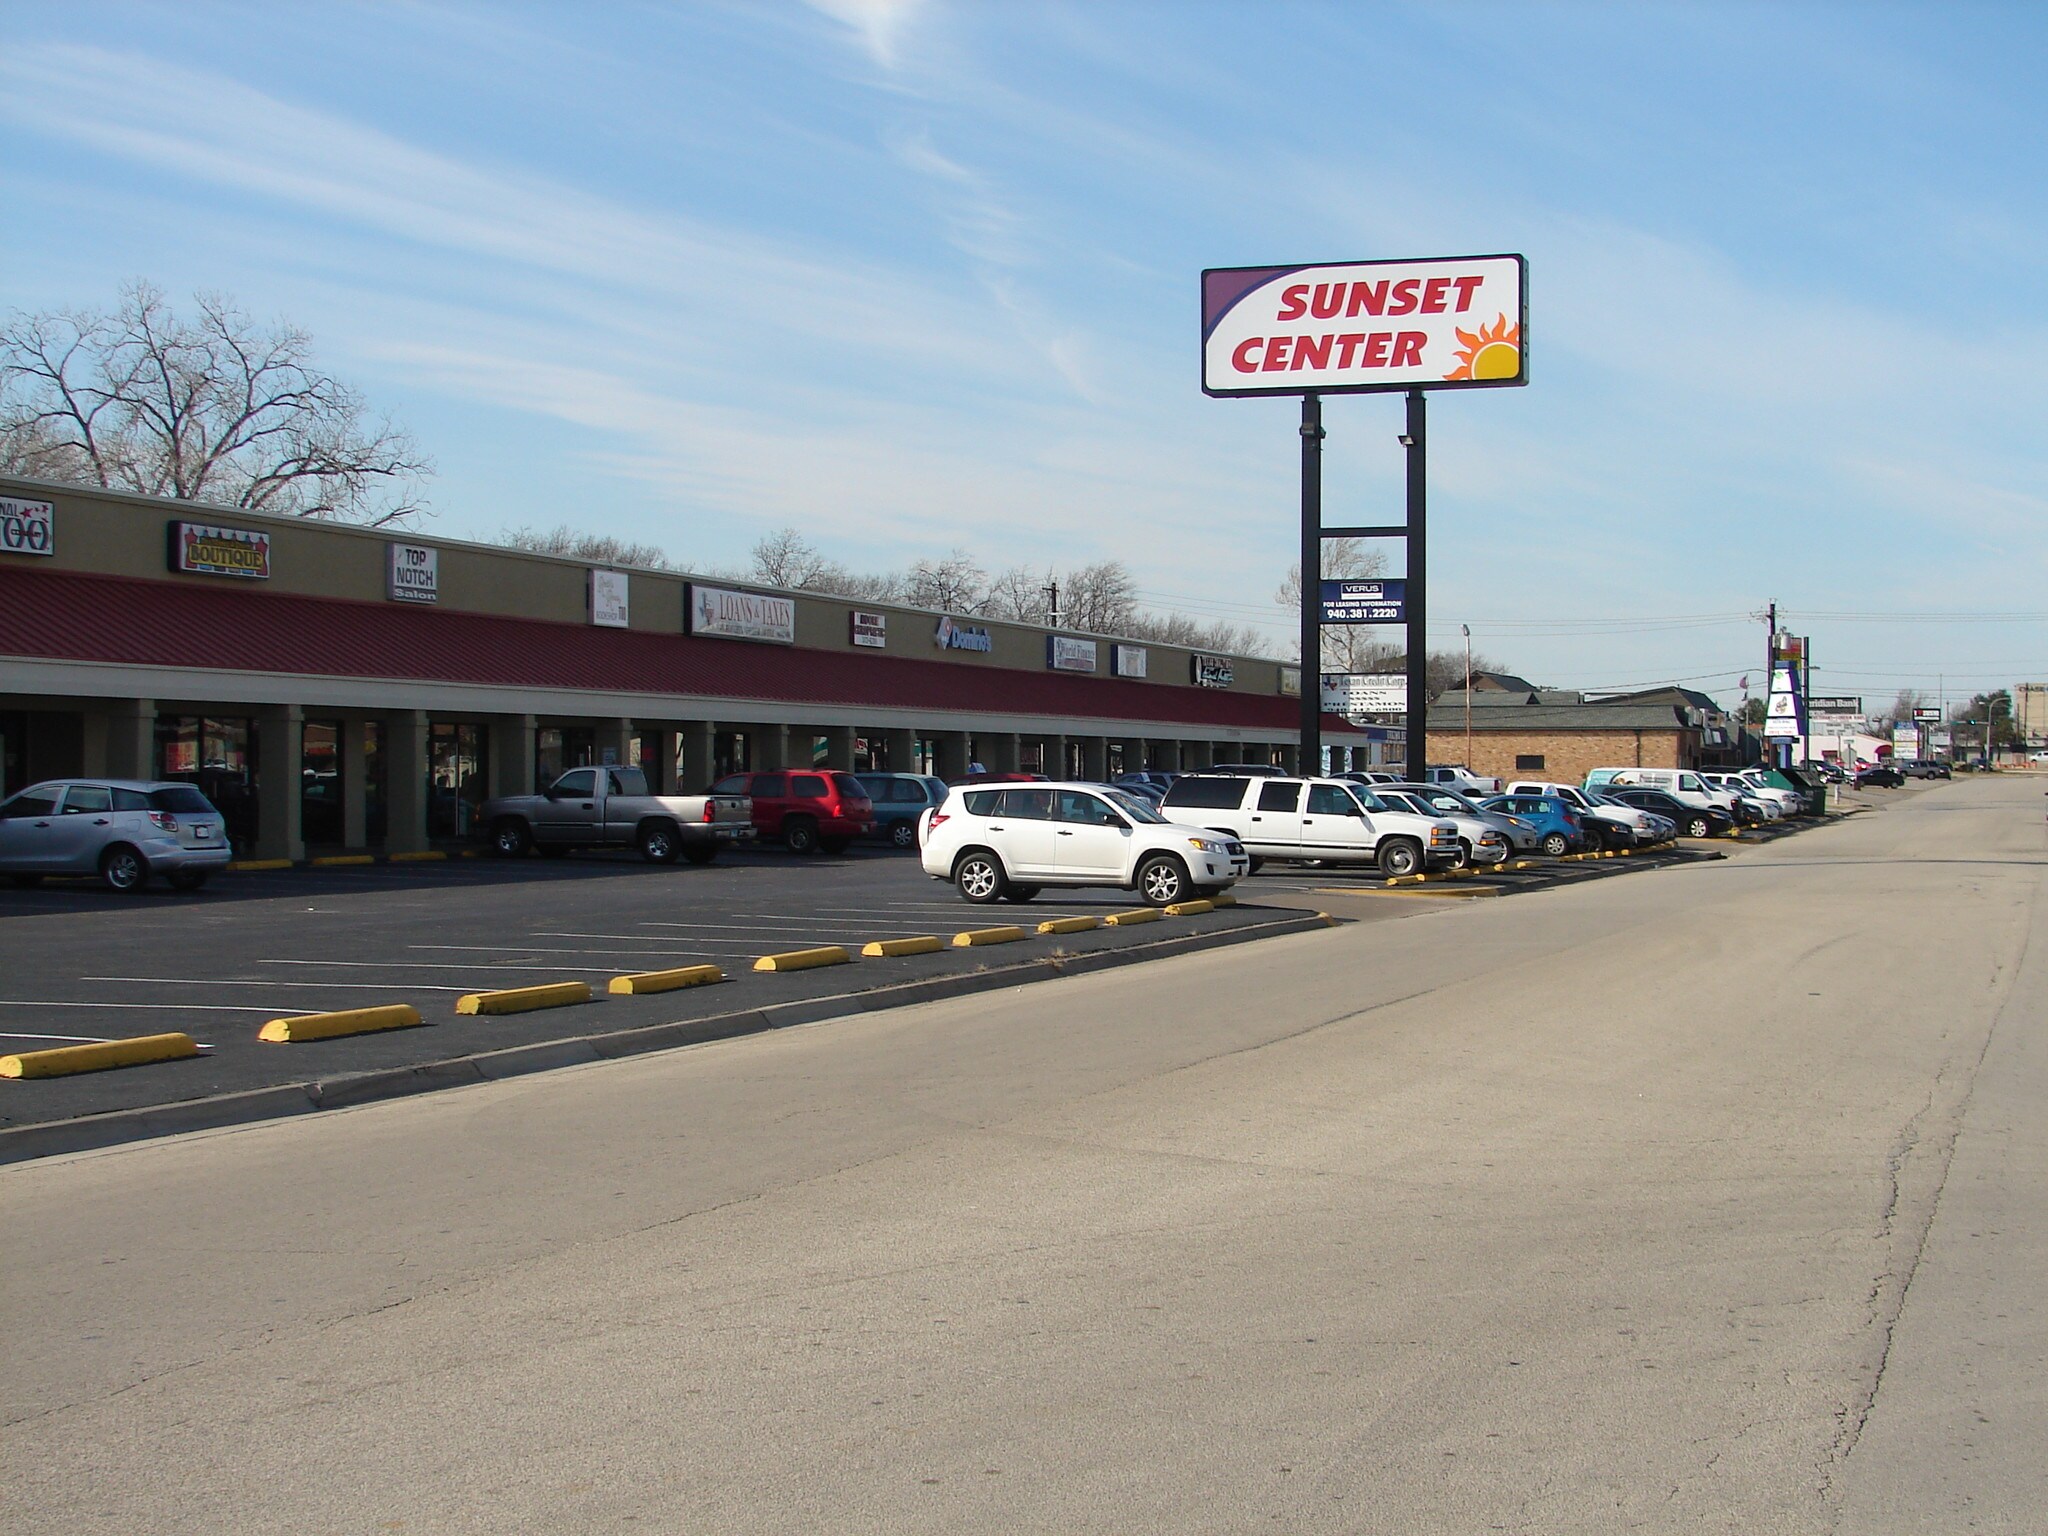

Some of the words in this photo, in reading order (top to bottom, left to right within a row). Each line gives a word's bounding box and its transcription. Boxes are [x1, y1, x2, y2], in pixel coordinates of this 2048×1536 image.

[1277, 275, 1484, 322] SUNSET
[1231, 331, 1428, 373] CENTER
[190, 545, 263, 568] BOUTIQUE
[405, 548, 427, 567] TOP
[396, 566, 434, 587] NOTCH
[394, 588, 437, 600] Salon
[1345, 584, 1380, 593] VERUS
[719, 594, 753, 624] LOANS
[761, 599, 790, 628] TAXES
[1327, 608, 1398, 619] 940.381.2220
[952, 625, 992, 652] Domino's
[1340, 675, 1361, 686] Texan
[1362, 675, 1385, 686] Credit
[1837, 698, 1859, 708] Bank
